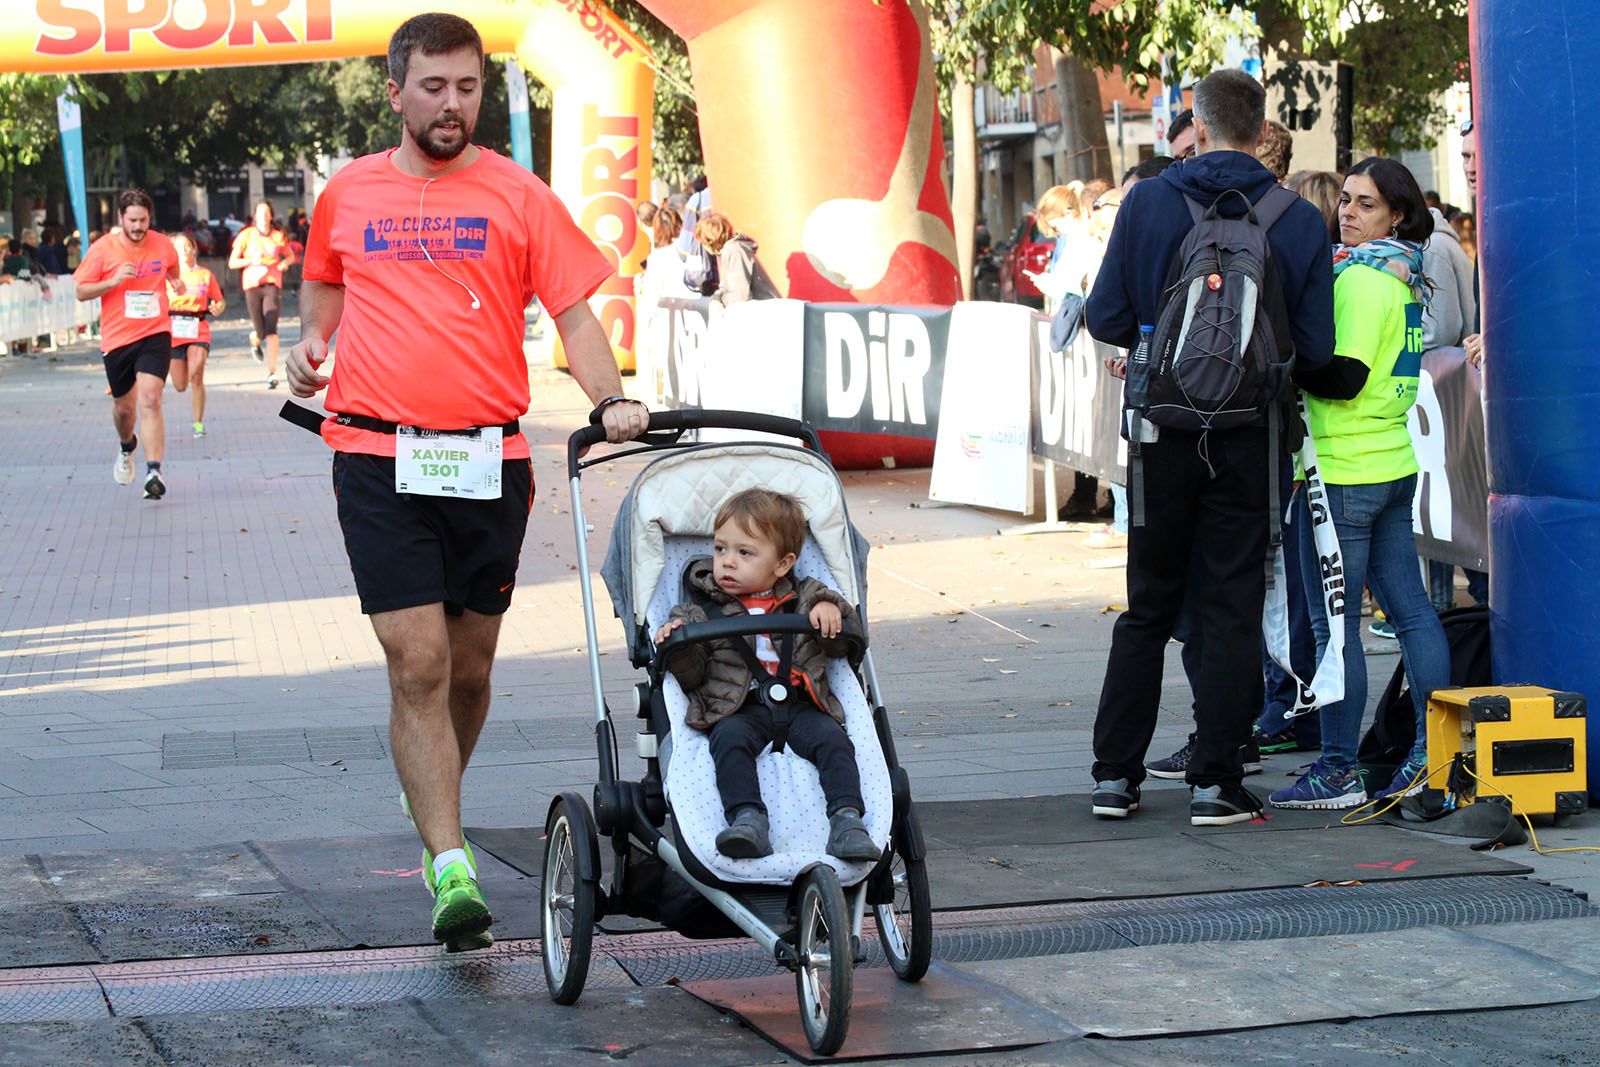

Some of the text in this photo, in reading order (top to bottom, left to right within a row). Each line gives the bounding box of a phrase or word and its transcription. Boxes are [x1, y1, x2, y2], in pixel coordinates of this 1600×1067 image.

[402, 217, 452, 232] CURSA
[823, 311, 932, 426] DiR
[411, 449, 470, 462] XAVIER
[420, 463, 461, 478] 1301
